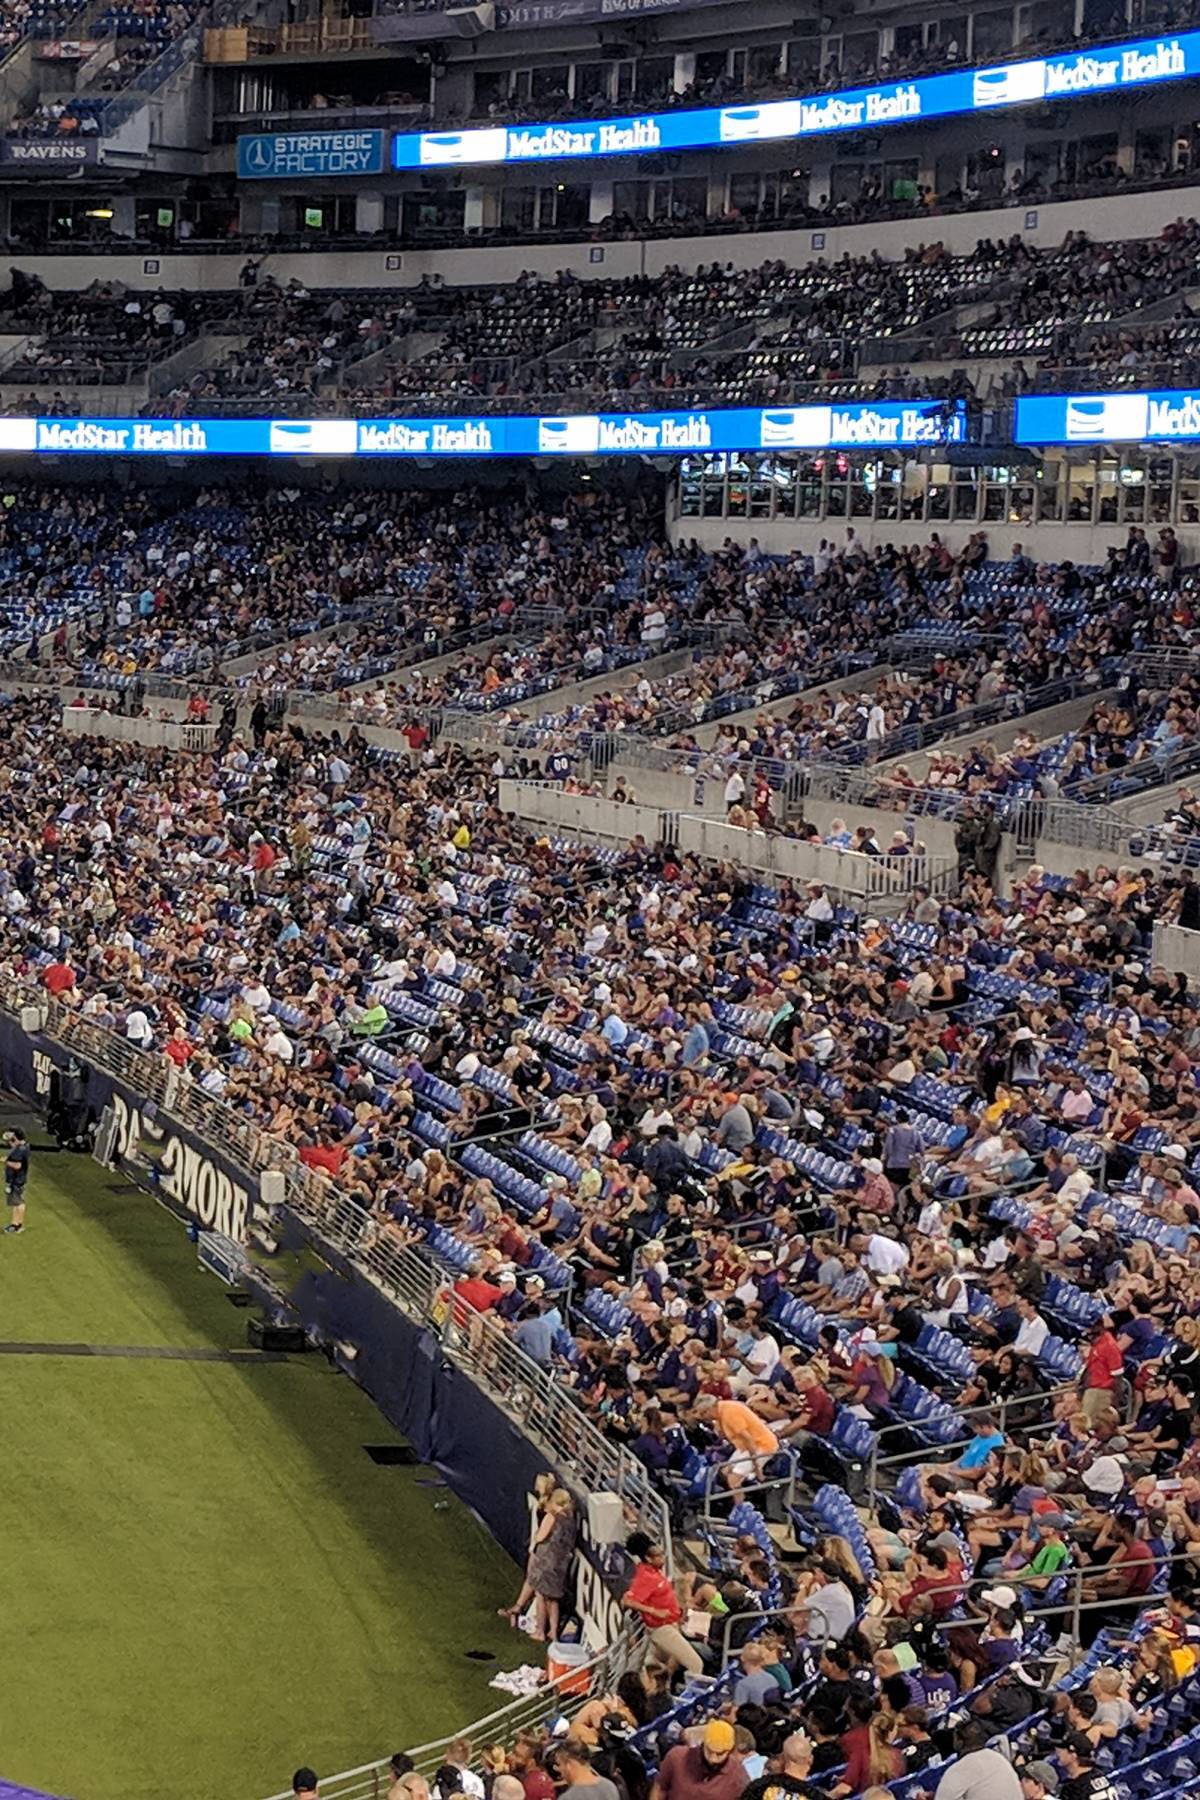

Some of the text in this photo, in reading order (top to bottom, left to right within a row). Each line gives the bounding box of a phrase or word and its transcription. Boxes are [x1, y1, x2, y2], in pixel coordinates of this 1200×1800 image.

[1046, 41, 1186, 93] MedStar Health
[801, 85, 921, 131] MedStar Health
[11, 146, 87, 158] RAVENS
[274, 133, 373, 153] STRATEGIC
[507, 119, 661, 158] MedStar Health
[273, 152, 371, 172] FACTORY
[38, 422, 208, 450] MedStar Health
[359, 421, 493, 450] MedStar Health
[599, 416, 711, 448] MedStar Health
[831, 408, 900, 443] MedStar
